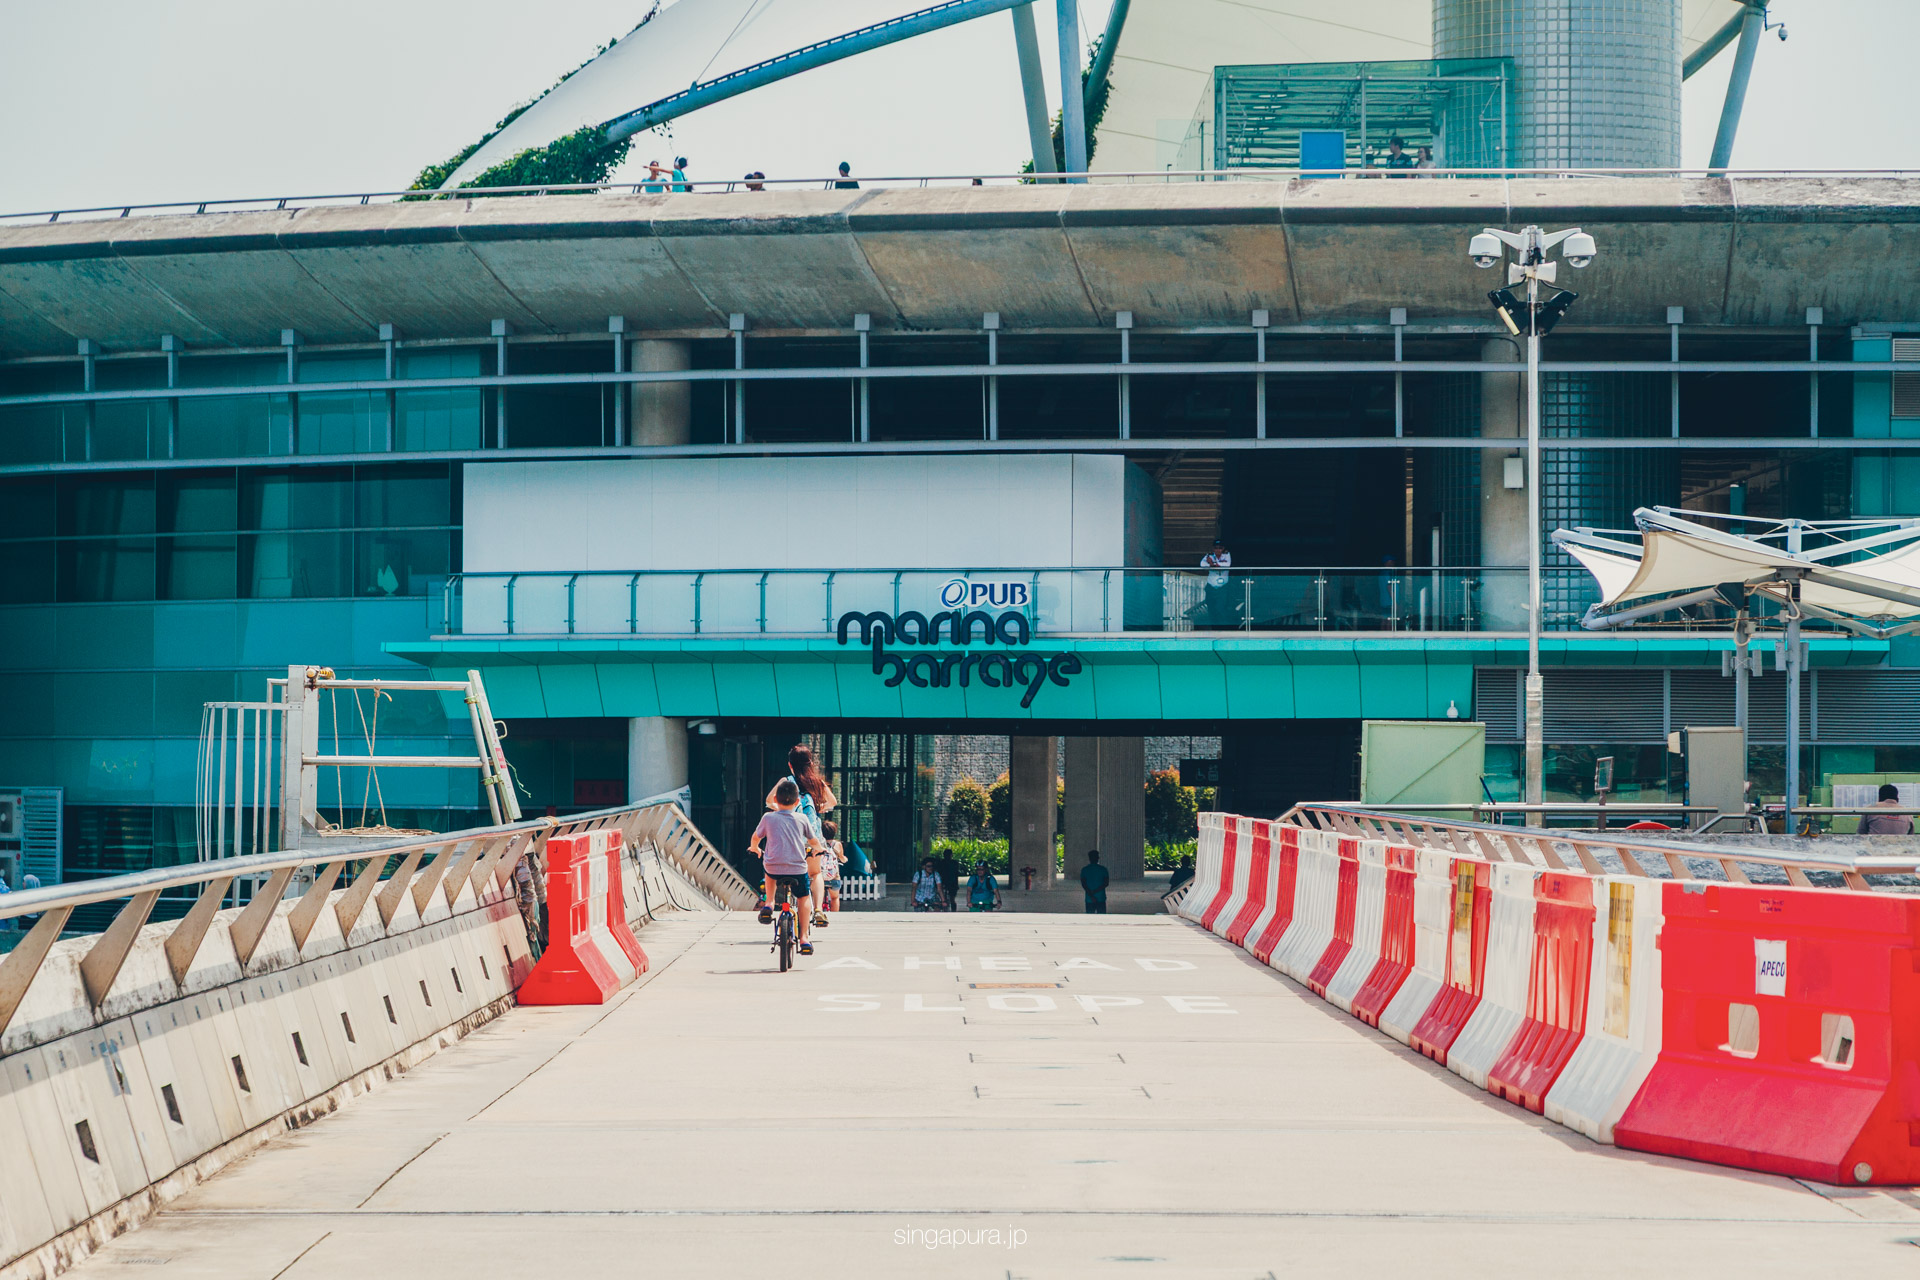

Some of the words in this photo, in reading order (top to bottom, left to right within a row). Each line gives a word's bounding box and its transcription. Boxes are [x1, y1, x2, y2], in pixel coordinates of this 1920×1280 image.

[971, 583, 1028, 605] PUB
[837, 610, 1030, 645] marina
[872, 625, 1082, 709] barrage
[813, 955, 1199, 972] AHEAD
[1760, 961, 1786, 977] APECO
[813, 993, 1239, 1014] SLOPE
